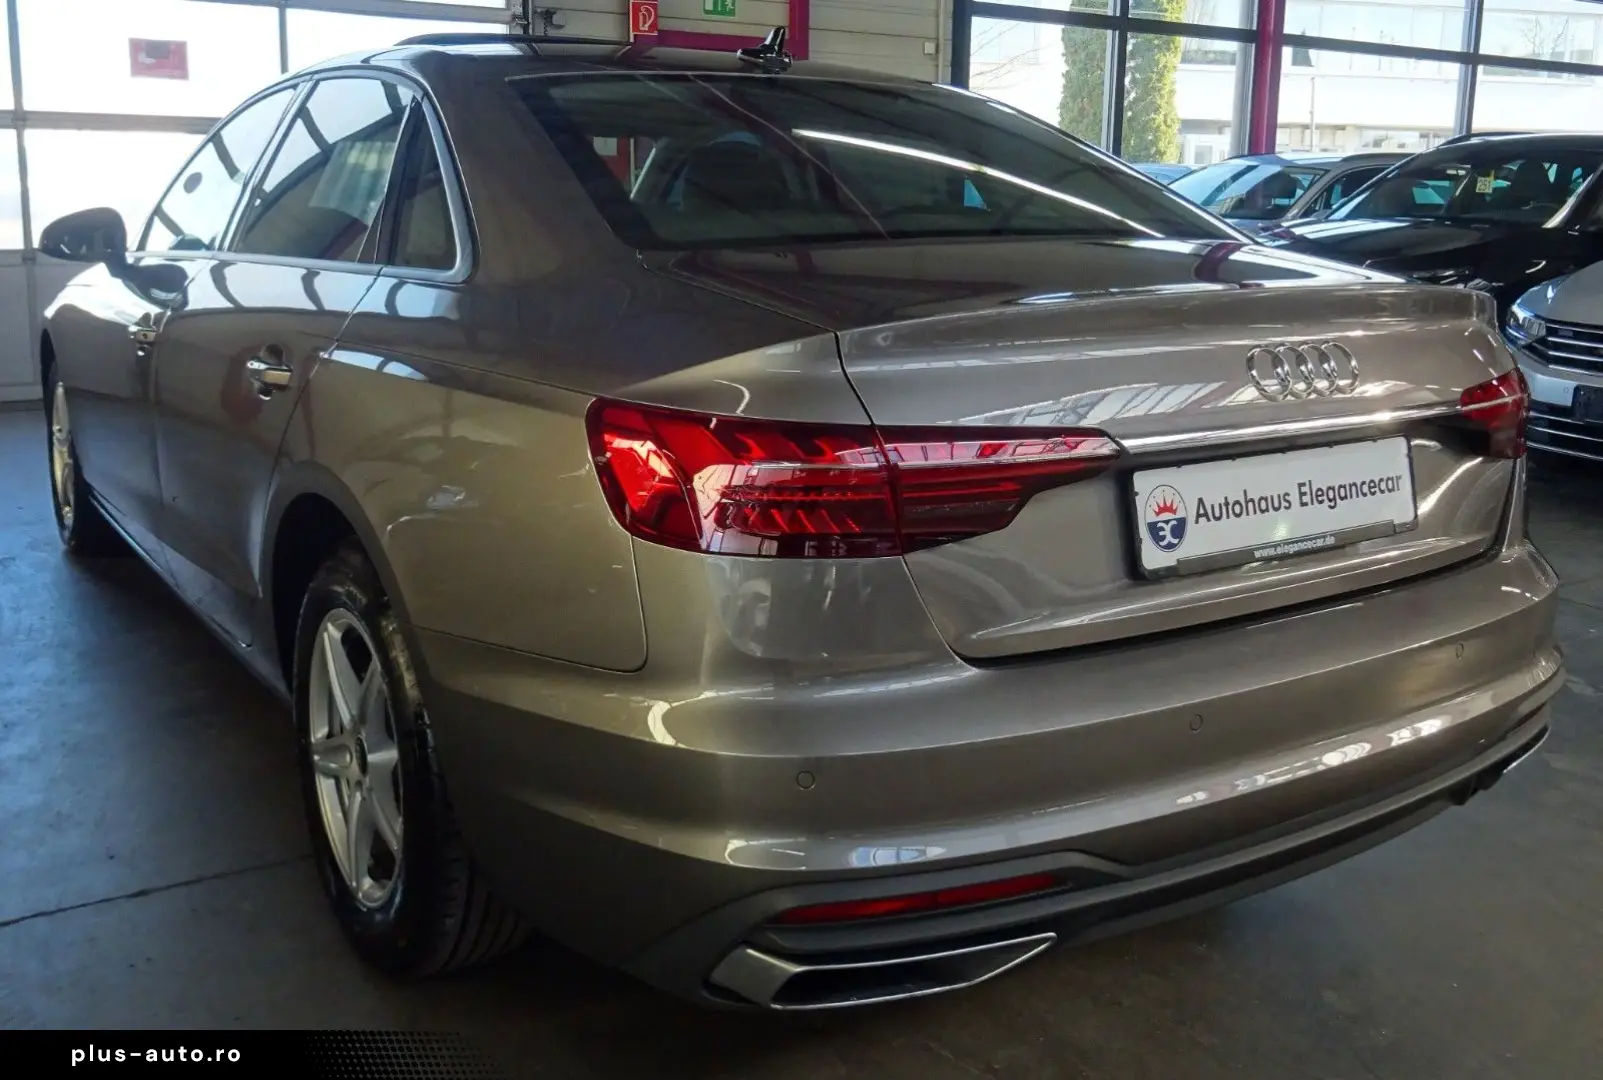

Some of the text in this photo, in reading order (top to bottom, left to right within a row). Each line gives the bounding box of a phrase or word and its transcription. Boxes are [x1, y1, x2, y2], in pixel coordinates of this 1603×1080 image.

[1194, 474, 1402, 524] Autohaus Elegancecar
[1253, 535, 1336, 558] www.elegancecar.de
